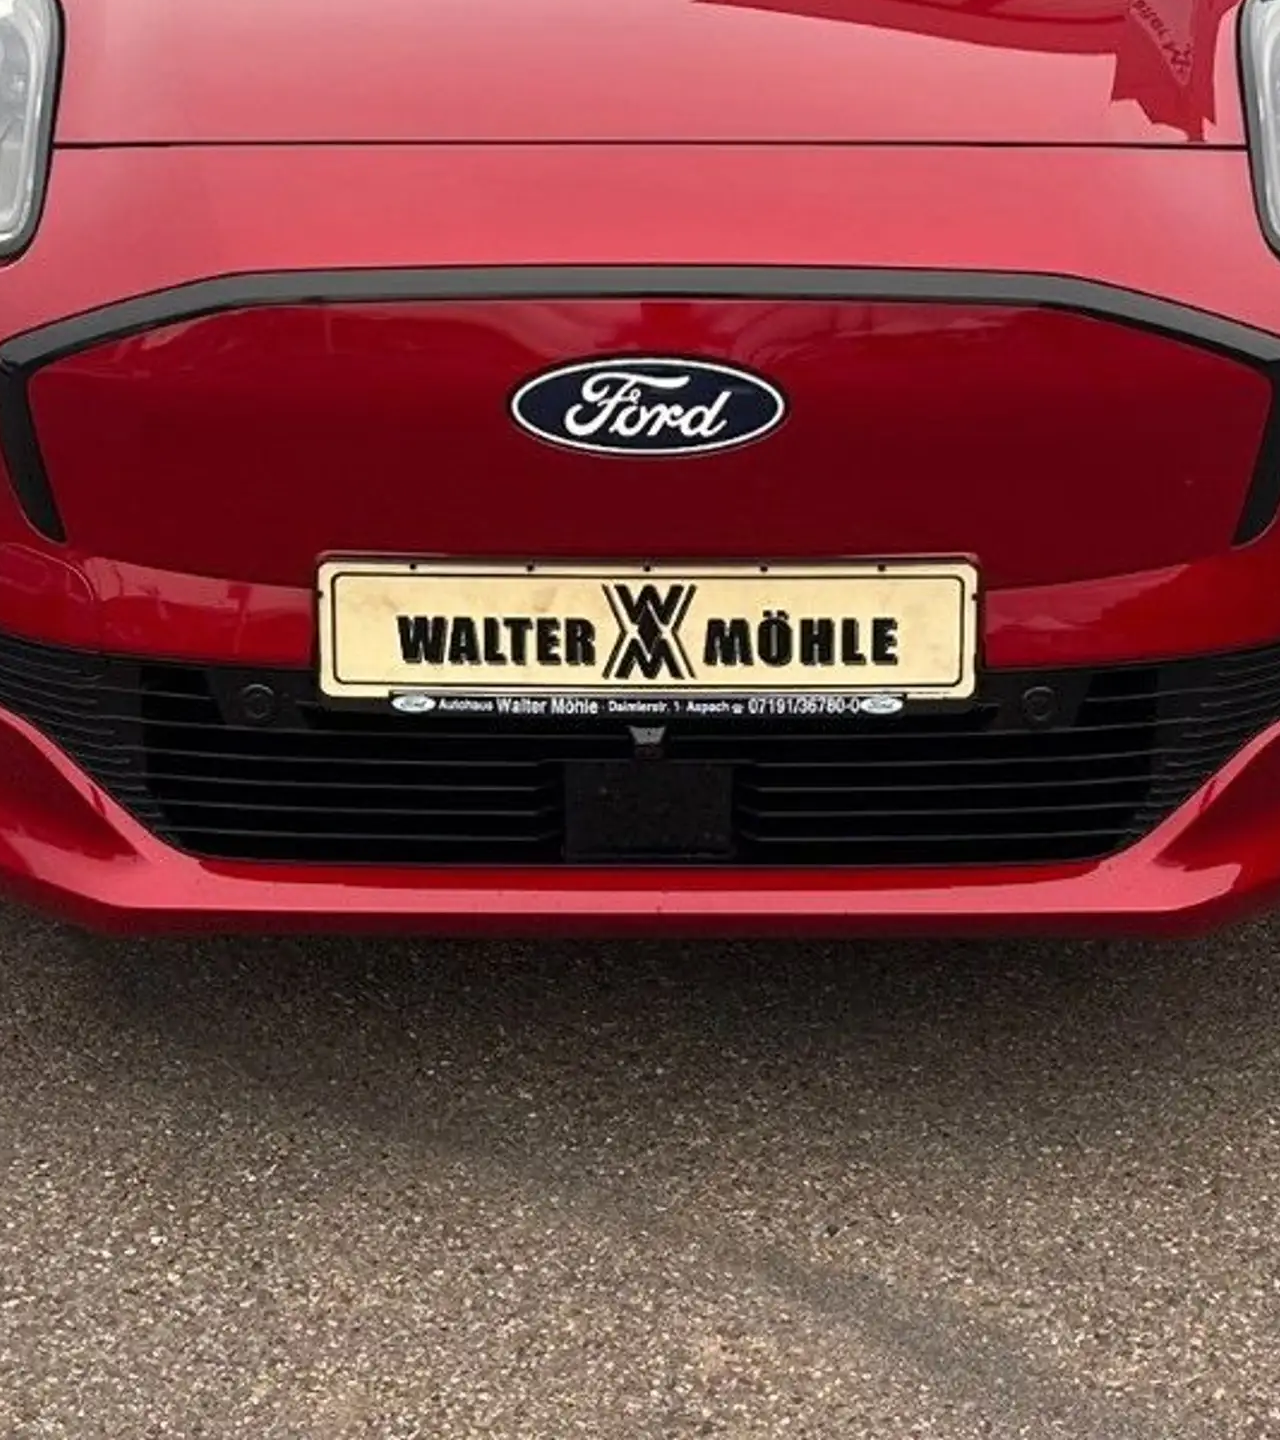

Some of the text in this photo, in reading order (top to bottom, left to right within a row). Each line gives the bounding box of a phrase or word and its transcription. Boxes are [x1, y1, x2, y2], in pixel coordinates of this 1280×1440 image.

[564, 371, 733, 437] Ford
[396, 609, 899, 665] WALTER MÖHLE
[438, 697, 493, 711] Autohaus
[496, 697, 547, 713] Walter
